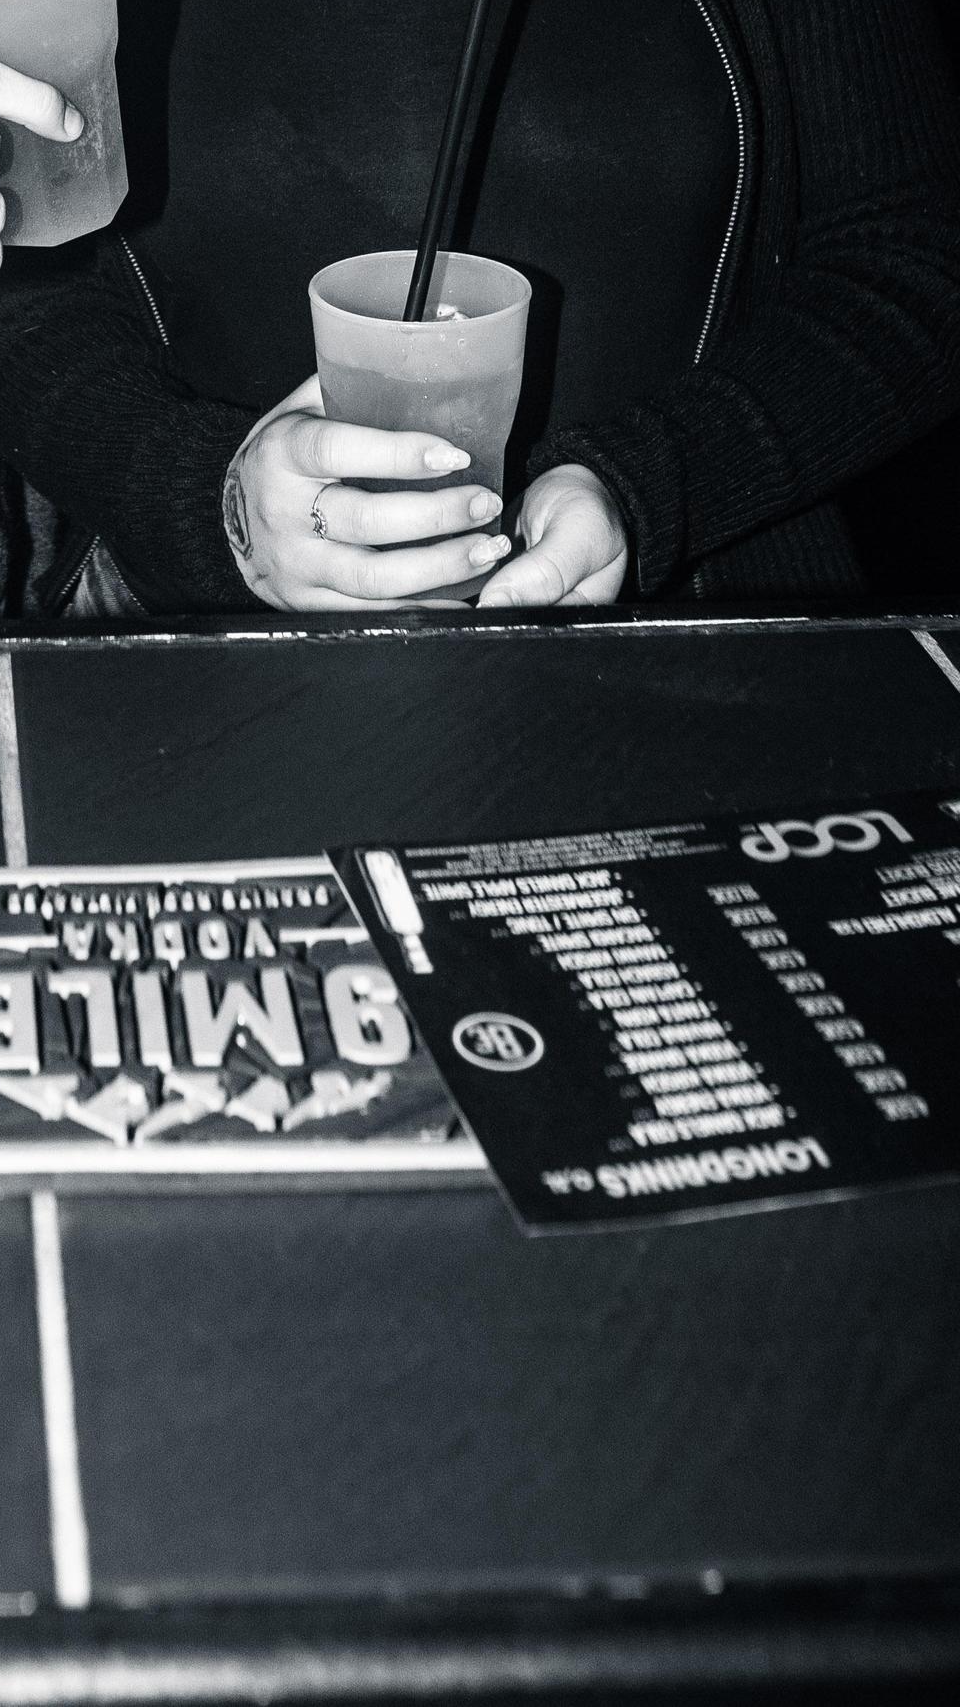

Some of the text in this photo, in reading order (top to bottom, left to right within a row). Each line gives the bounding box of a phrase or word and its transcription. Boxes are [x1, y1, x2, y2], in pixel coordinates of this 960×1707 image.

[740, 810, 915, 864] LOOP
[61, 919, 278, 967] VODKA
[323, 964, 413, 1068] 9
[597, 1137, 832, 1199] LONGDRINKS
